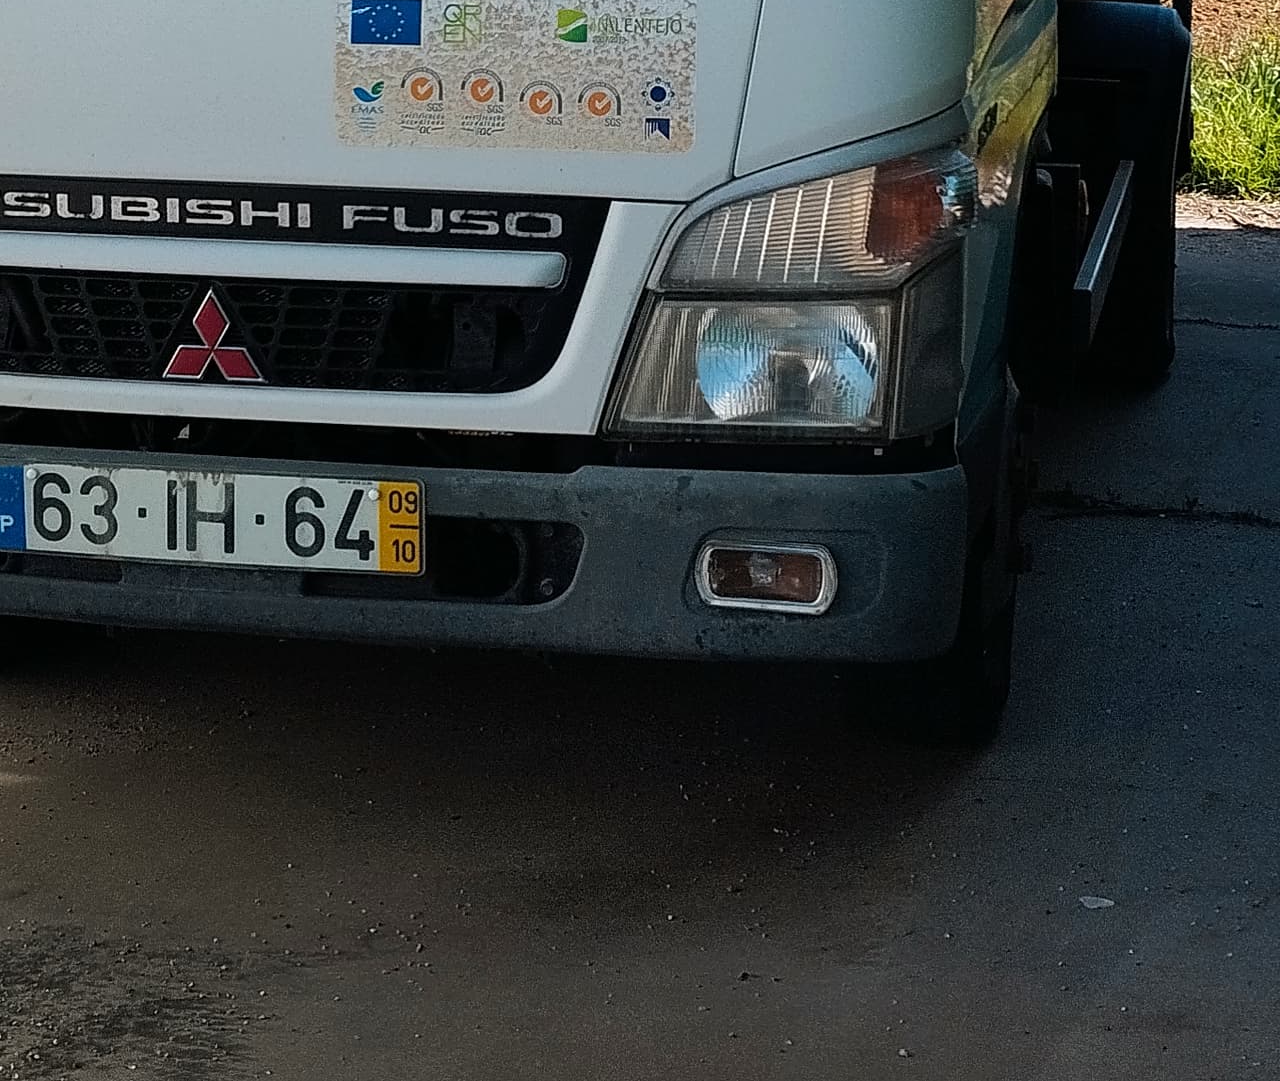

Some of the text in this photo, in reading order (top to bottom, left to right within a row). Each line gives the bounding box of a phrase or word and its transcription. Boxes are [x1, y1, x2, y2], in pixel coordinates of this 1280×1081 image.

[426, 102, 444, 112] SGS
[486, 104, 504, 113] SGS
[546, 116, 563, 126] SGS
[604, 118, 622, 127] SGS
[341, 204, 565, 239] FUSO
[388, 490, 418, 515] 09
[0, 514, 15, 533] P
[392, 538, 417, 563] 10
